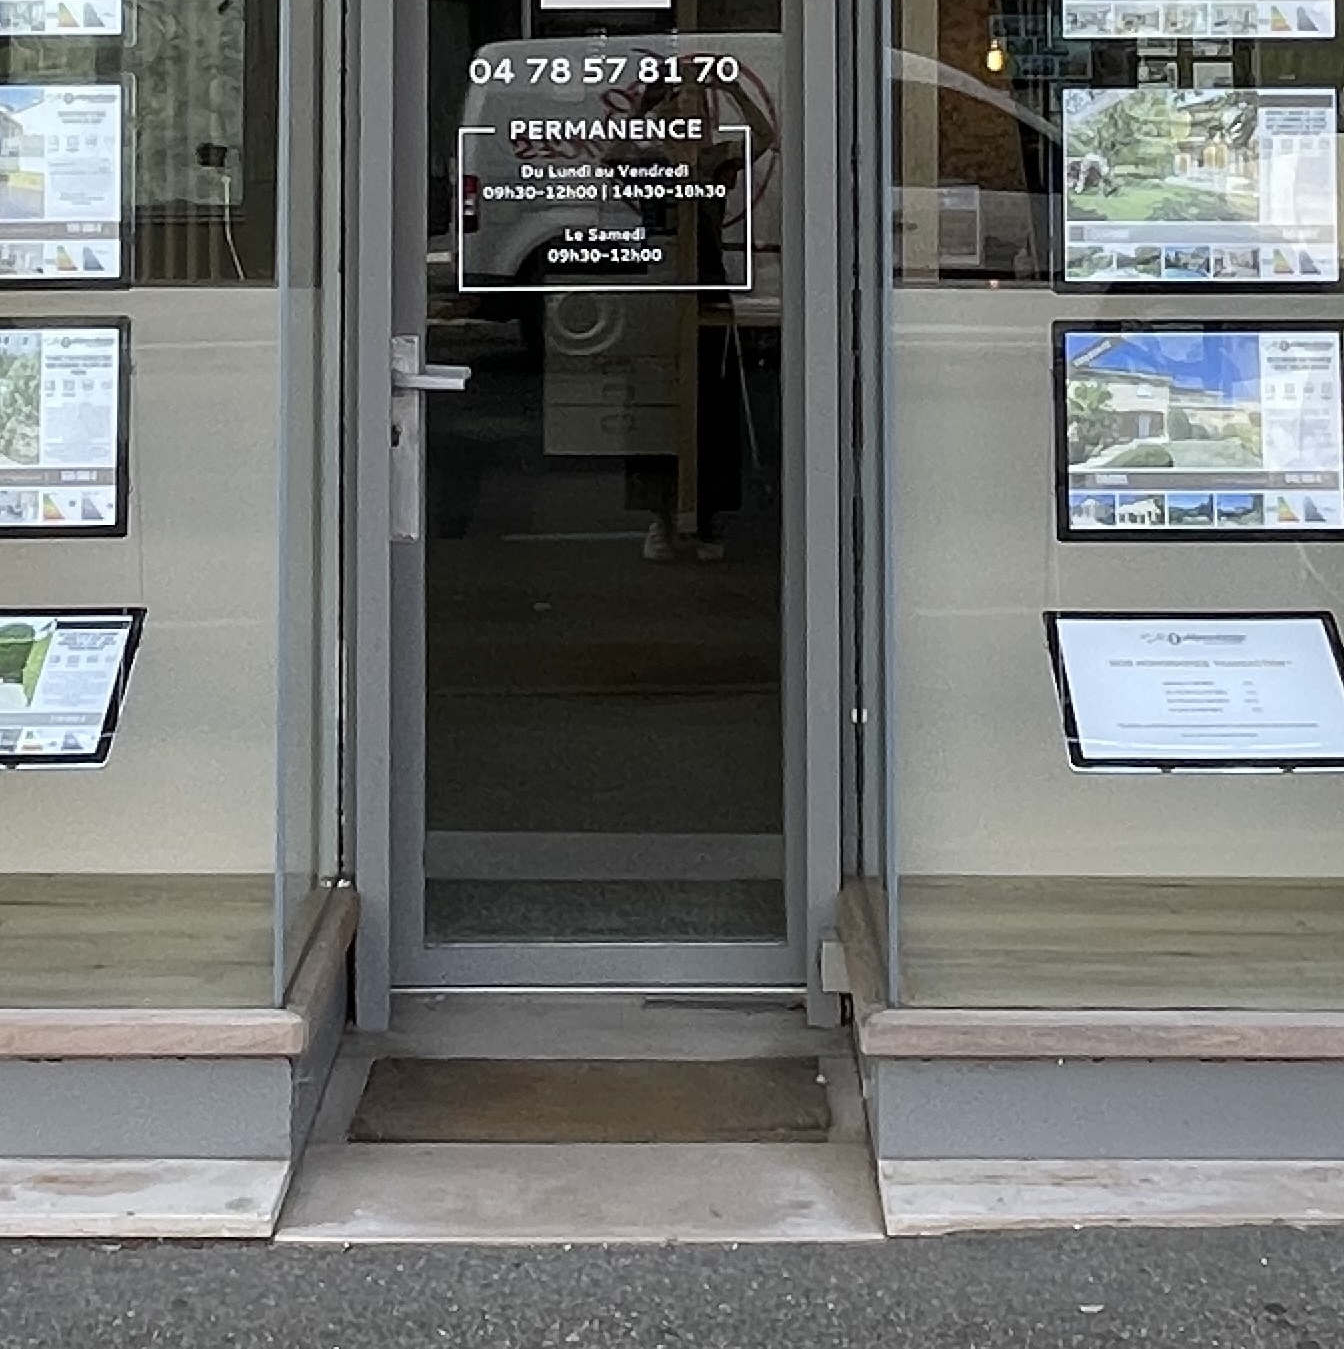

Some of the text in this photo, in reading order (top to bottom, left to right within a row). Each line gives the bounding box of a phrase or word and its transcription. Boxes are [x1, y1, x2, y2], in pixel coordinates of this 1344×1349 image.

[469, 57, 739, 84] 04 78 57 81 70
[510, 119, 702, 140] PERMANENCE
[521, 164, 689, 178] Du Lundi au Vendredi
[565, 228, 646, 241] Le Samedi
